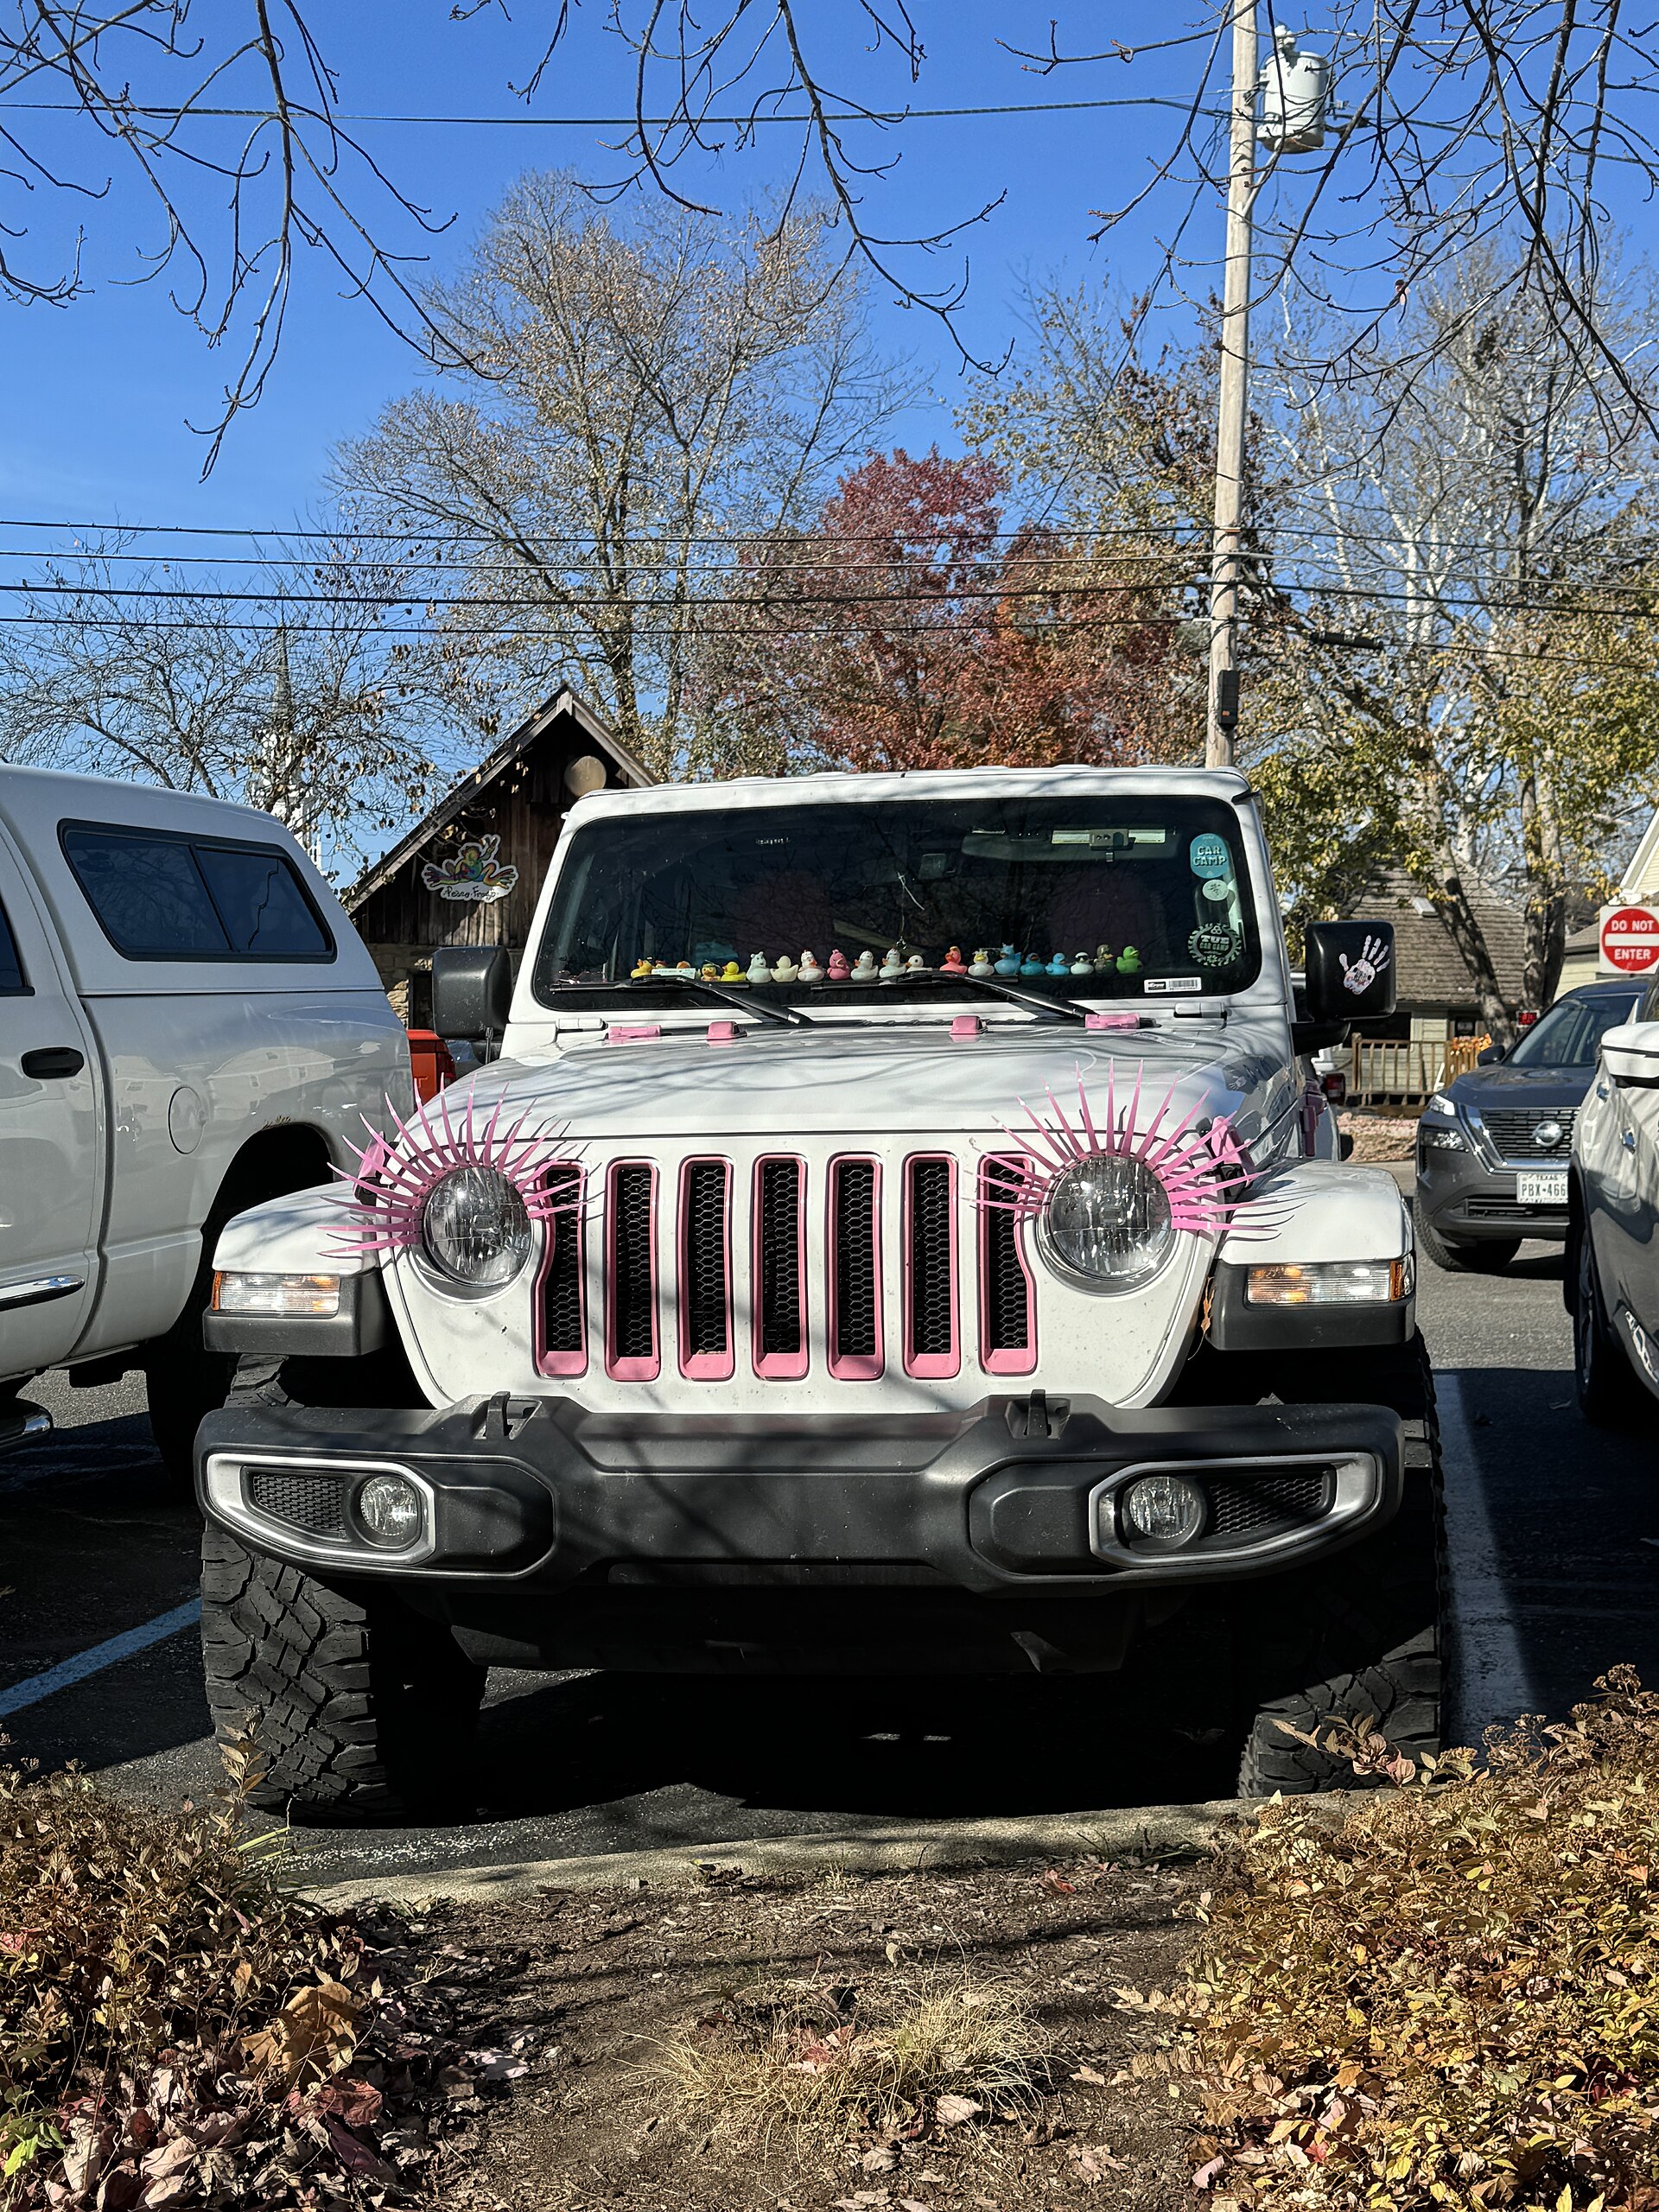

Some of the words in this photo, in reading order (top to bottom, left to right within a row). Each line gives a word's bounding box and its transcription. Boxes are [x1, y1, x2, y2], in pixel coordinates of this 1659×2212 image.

[1198, 846, 1222, 855] CAR
[1193, 855, 1227, 867] CAMP
[1611, 920, 1628, 931] DO
[1632, 920, 1654, 931] NOT
[1614, 949, 1651, 960] ENTER
